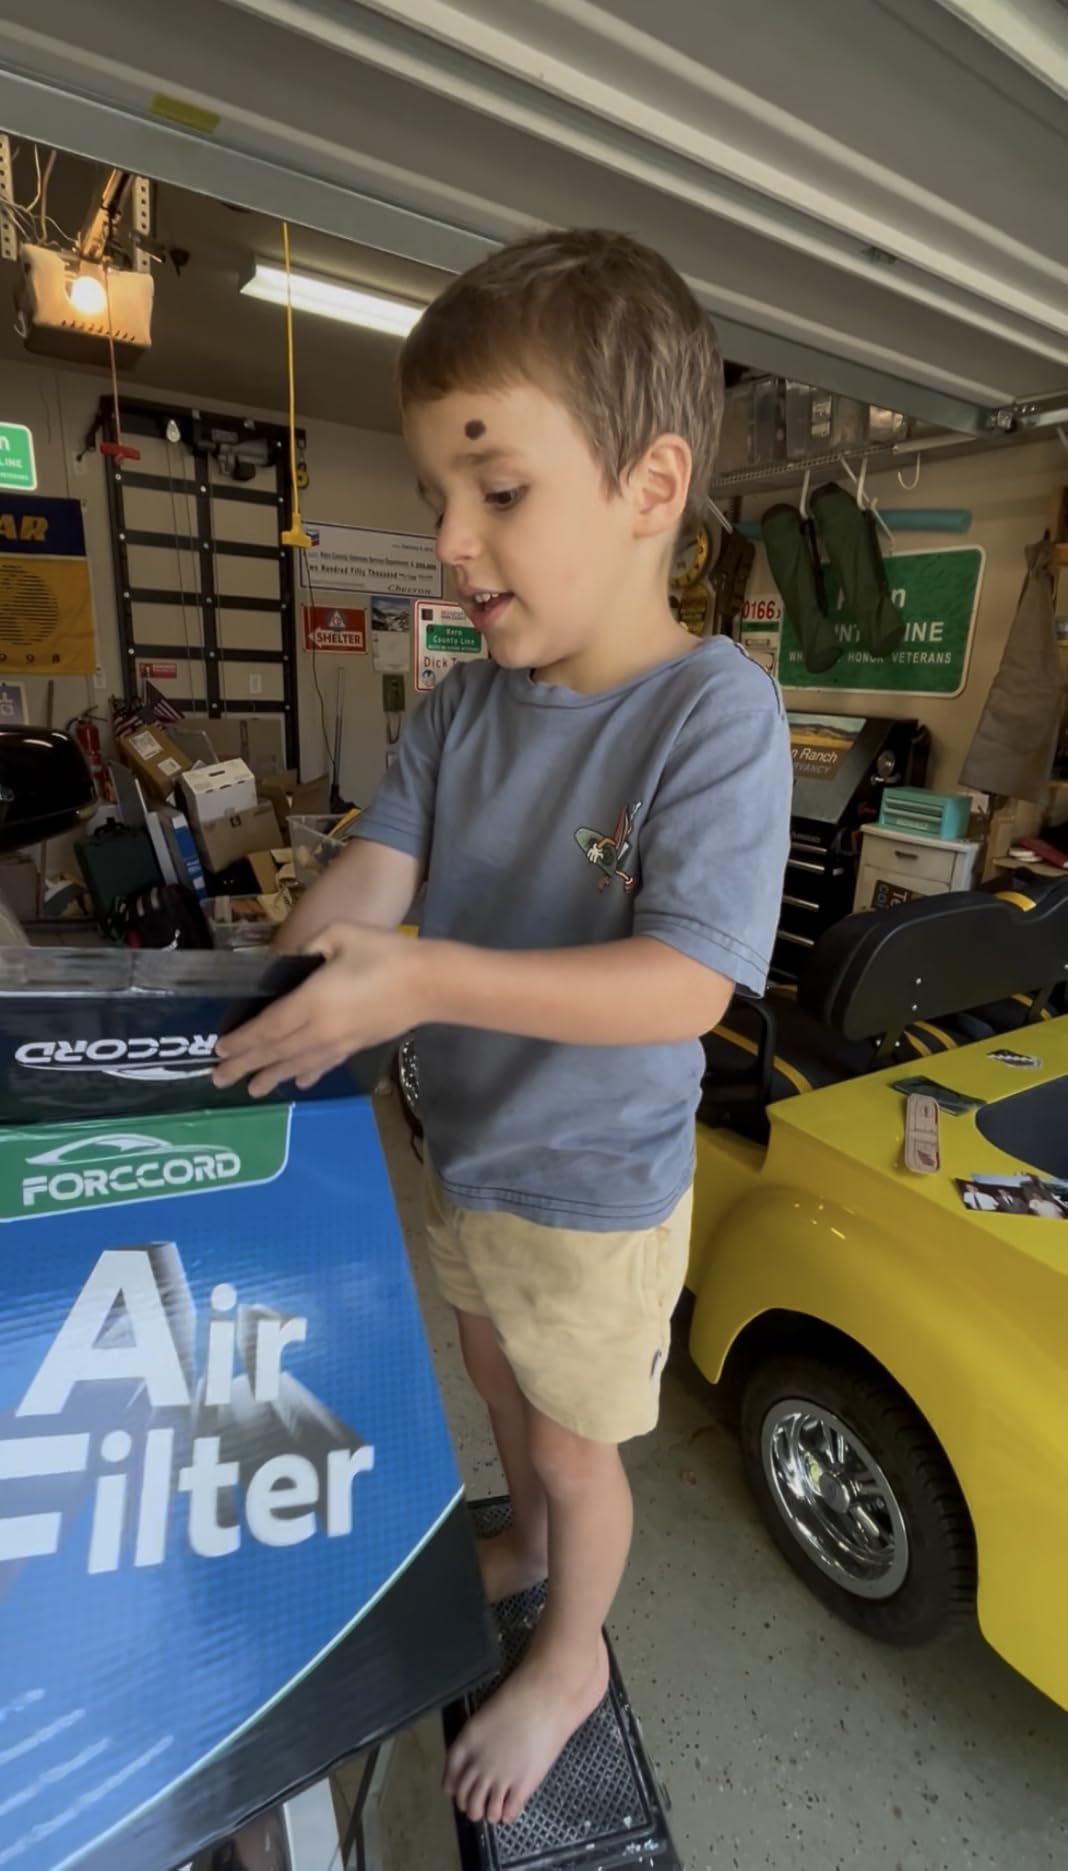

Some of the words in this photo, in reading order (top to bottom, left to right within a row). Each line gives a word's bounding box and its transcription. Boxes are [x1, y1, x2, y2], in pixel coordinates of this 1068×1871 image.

[316, 631, 361, 645] SHELTER
[903, 621, 944, 642] INE
[424, 656, 449, 669] Dick
[891, 651, 952, 664] VETERANS
[799, 747, 839, 763] Ranch
[14, 1033, 219, 1064] RCCORD
[22, 1152, 241, 1206] FORCCORD
[16, 1248, 307, 1418] Air
